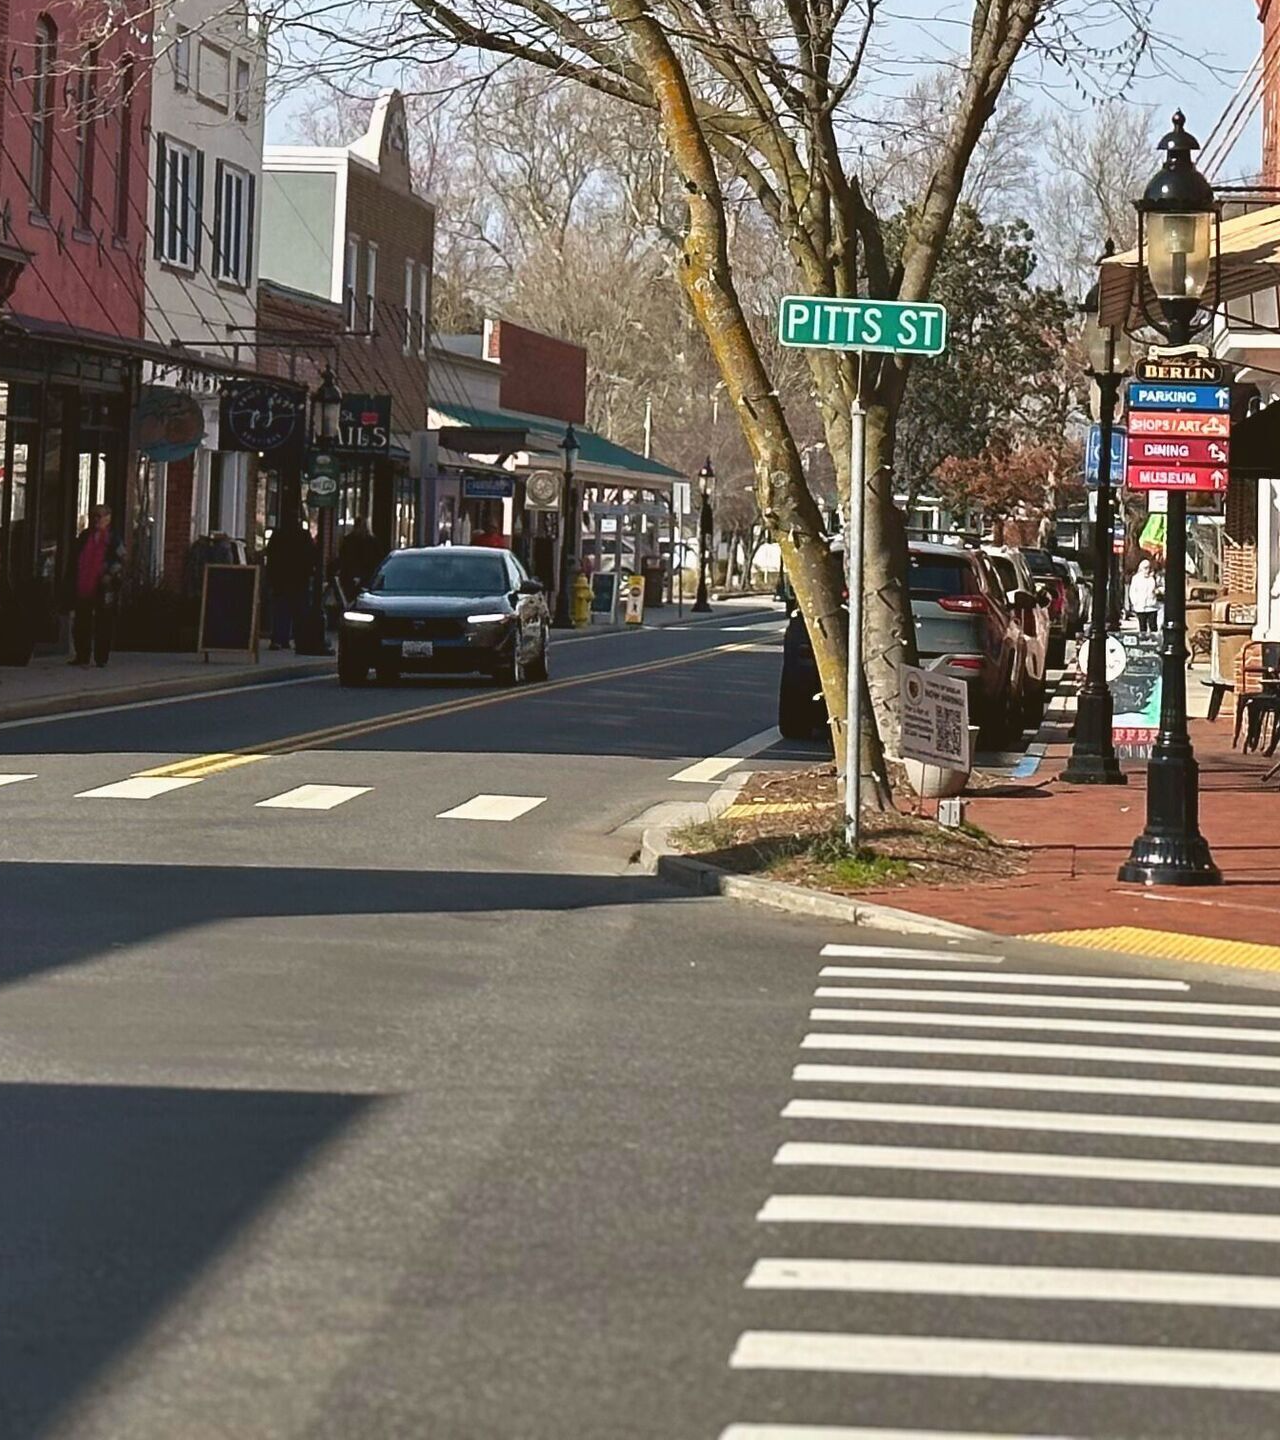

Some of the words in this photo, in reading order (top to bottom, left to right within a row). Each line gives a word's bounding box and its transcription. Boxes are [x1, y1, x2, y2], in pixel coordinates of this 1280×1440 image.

[787, 303, 883, 344] PITTS
[897, 309, 939, 346] ST
[1145, 364, 1216, 380] BERLIN
[1138, 390, 1197, 403] PARKING
[1131, 419, 1169, 431] SHOPS
[1177, 420, 1201, 432] ART
[1144, 444, 1190, 456] DINING
[1139, 471, 1197, 484] MUSEUM
